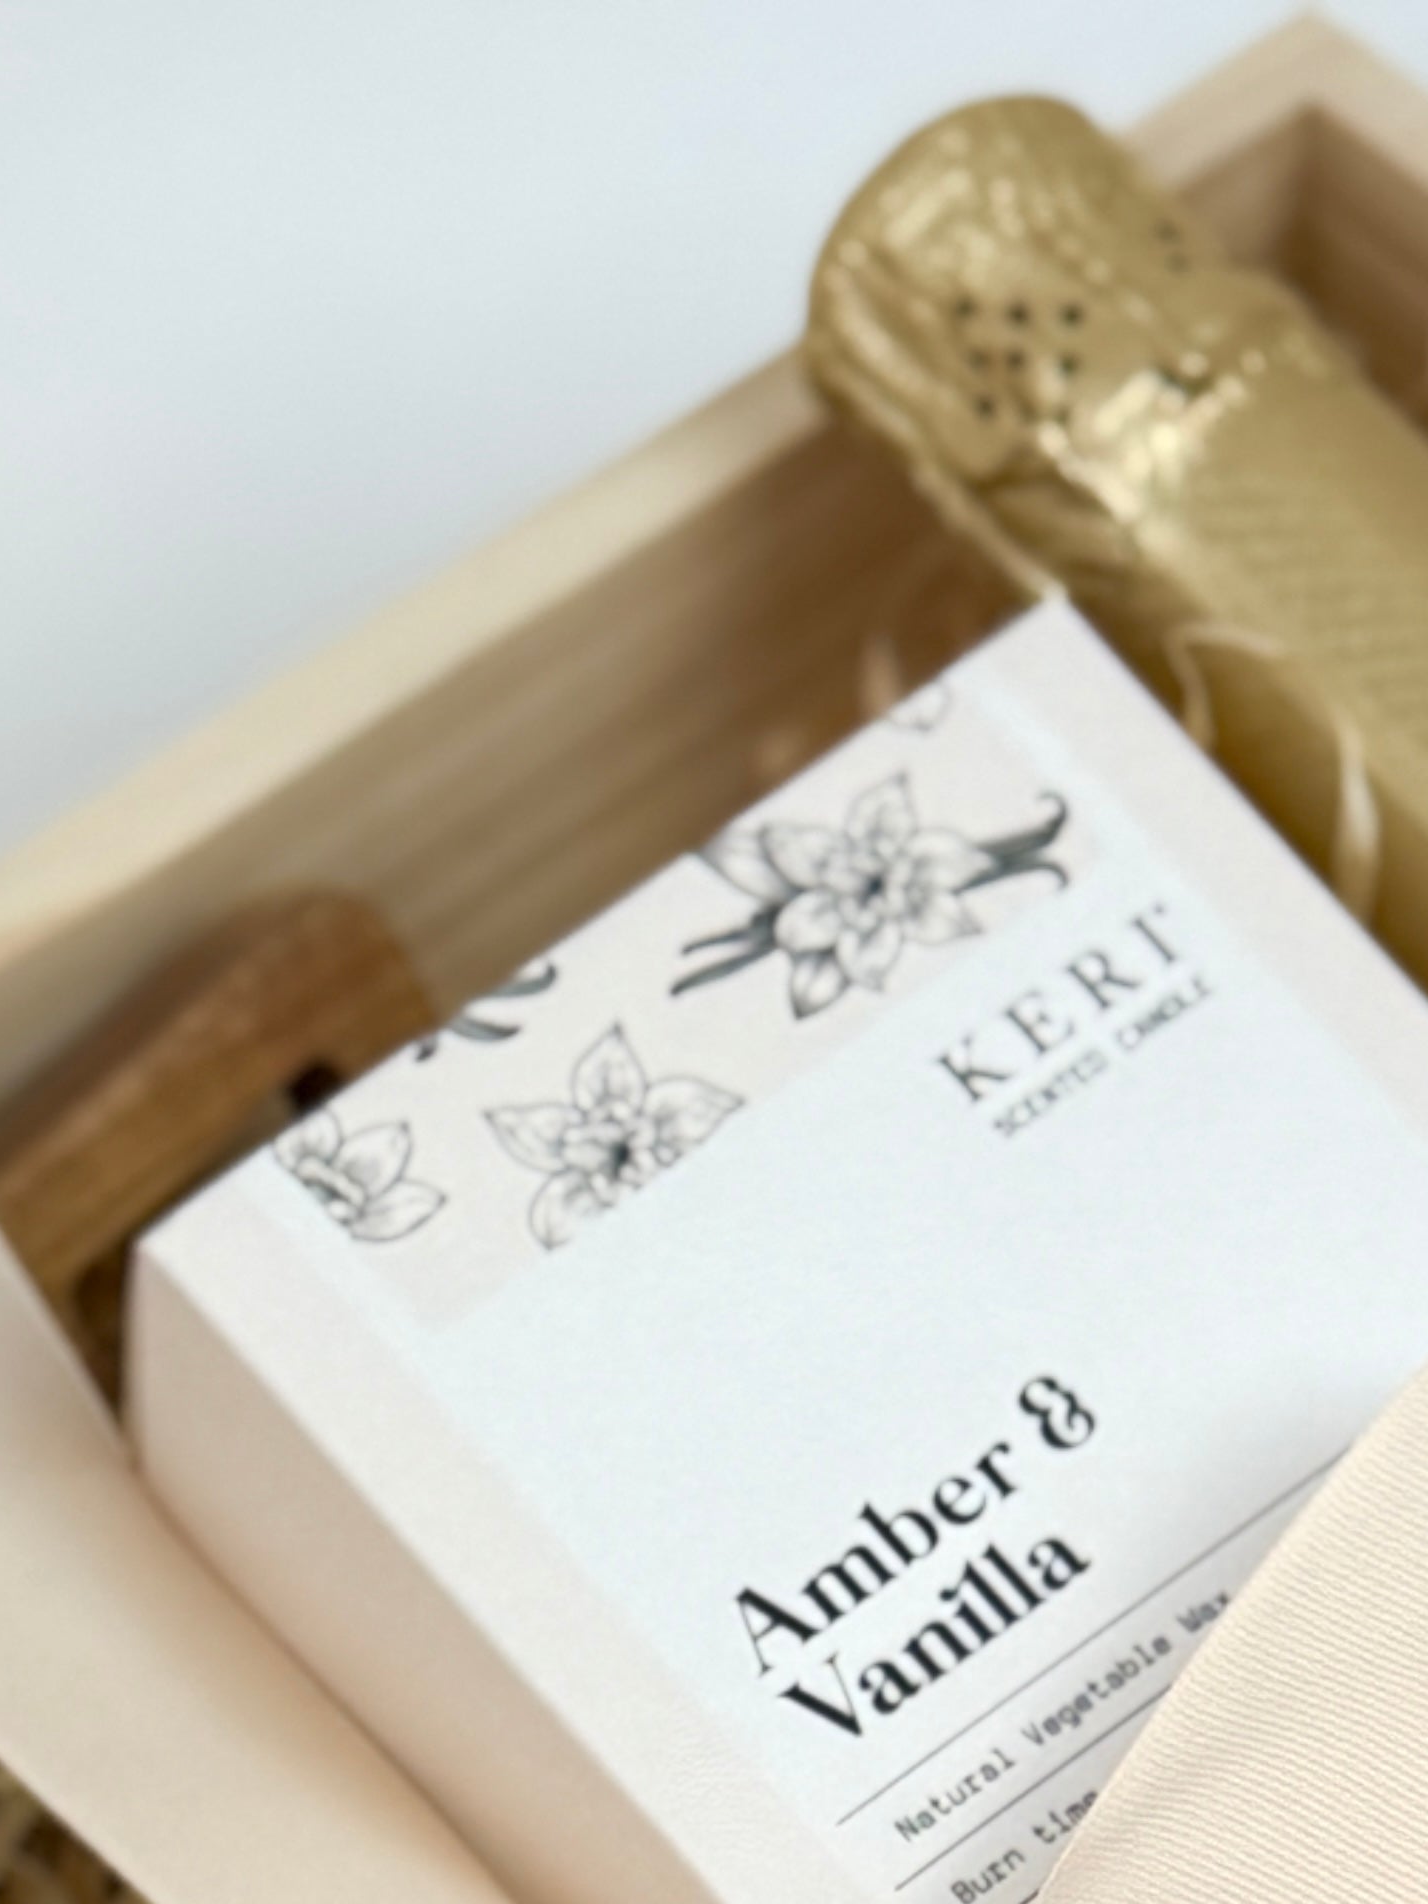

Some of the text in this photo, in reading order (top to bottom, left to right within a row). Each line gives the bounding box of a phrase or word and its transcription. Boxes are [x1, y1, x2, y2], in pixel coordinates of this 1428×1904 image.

[733, 1374, 1096, 1677] Amber &
[777, 1536, 1091, 1738] Vanilla
[893, 1590, 1232, 1843] Natural Vegetable Wax
